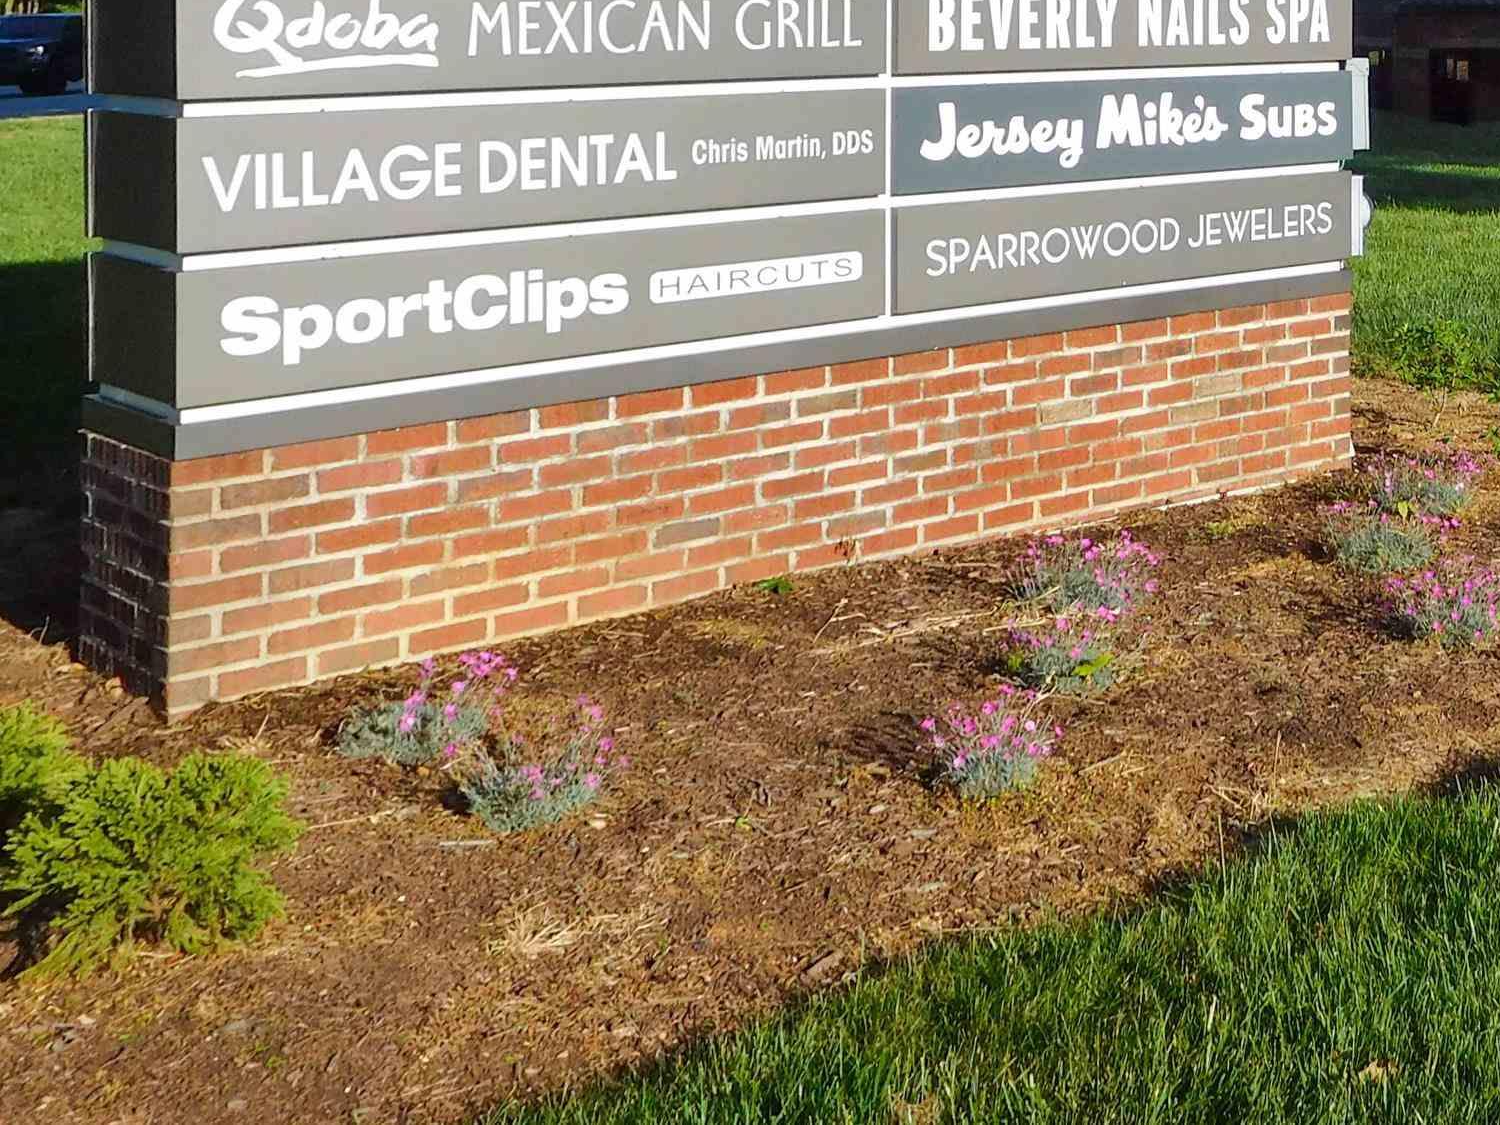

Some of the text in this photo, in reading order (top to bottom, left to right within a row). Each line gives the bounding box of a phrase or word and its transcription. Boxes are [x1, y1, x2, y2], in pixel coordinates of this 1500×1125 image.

[467, 0, 711, 57] MEXICAN
[919, 102, 1084, 169] Jersey
[1096, 91, 1229, 149] Mike's
[201, 129, 874, 213] VILLAGE DENTAL Chris Martin, DDS
[926, 202, 1332, 277] SPARROWOOD JEWELERS
[220, 257, 853, 366] SportClips HAIRCUTS
